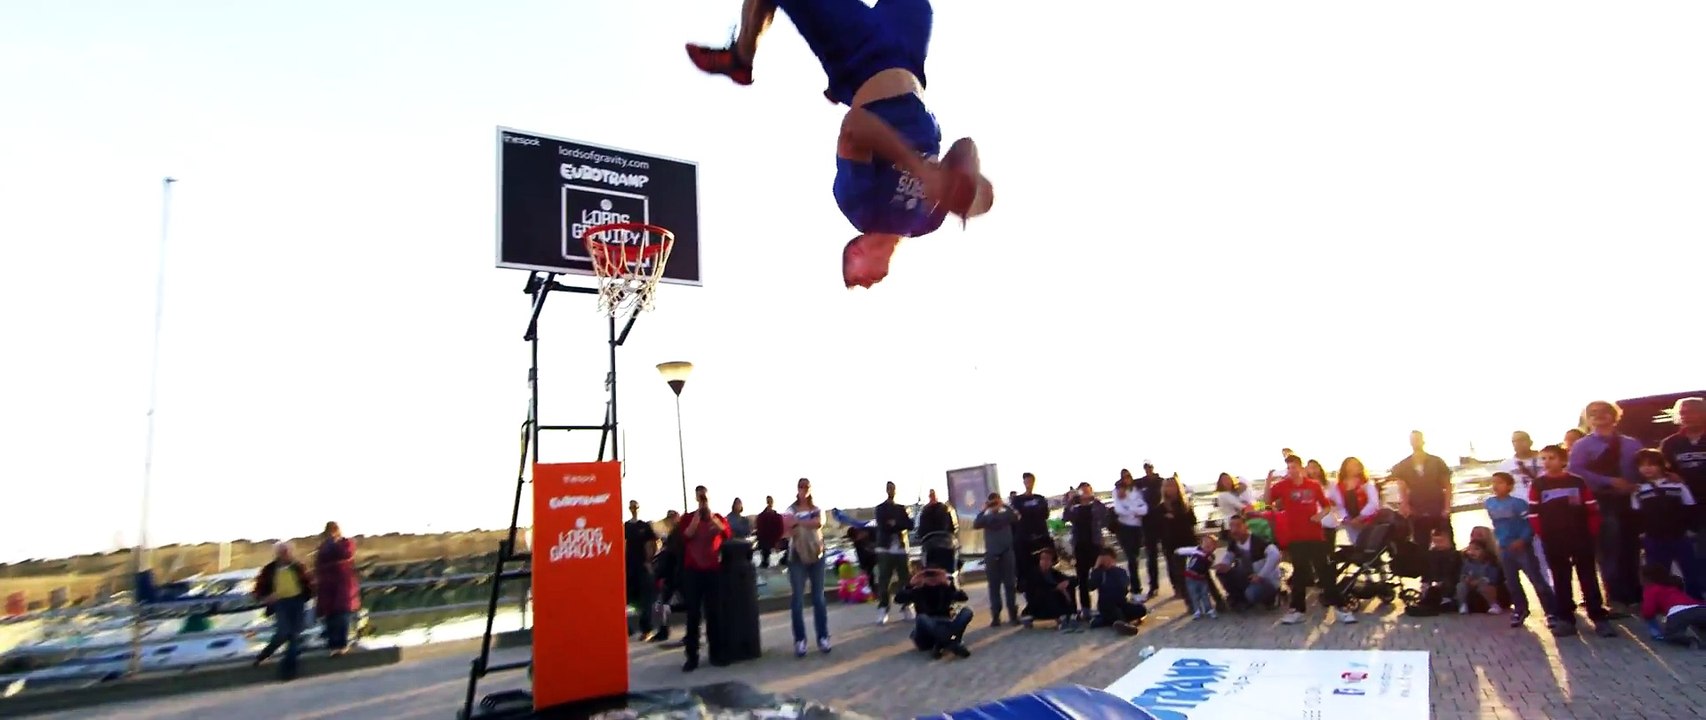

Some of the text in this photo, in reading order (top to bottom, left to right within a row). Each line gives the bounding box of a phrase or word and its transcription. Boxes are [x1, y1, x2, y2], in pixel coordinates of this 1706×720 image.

[558, 145, 650, 170] lordsofgravity.com
[582, 209, 631, 225] LORDS
[572, 223, 641, 245] GVITY
